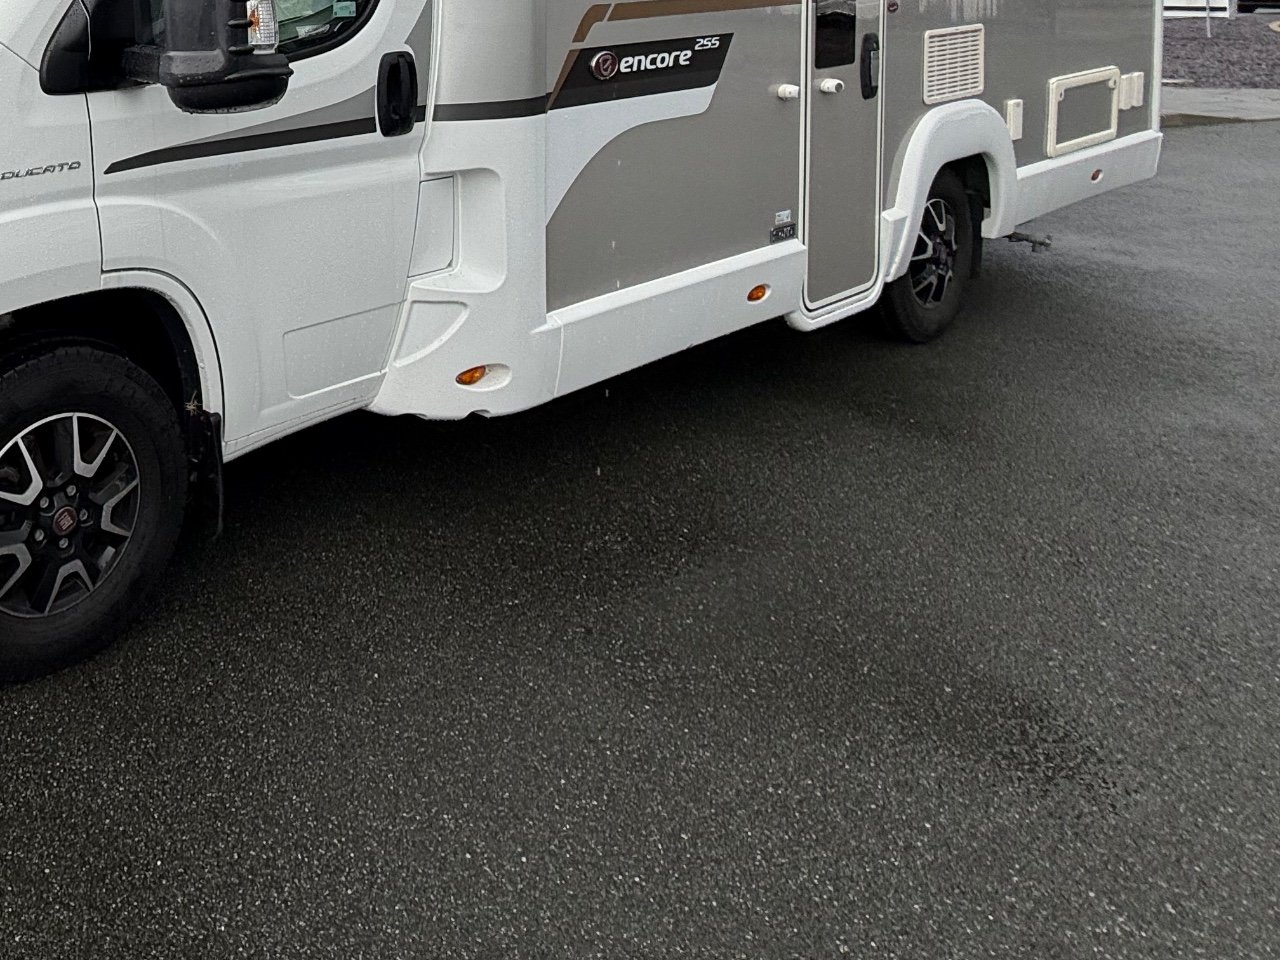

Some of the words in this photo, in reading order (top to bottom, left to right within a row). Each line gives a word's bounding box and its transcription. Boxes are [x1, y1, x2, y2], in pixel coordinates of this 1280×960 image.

[619, 49, 693, 73] encore
[694, 36, 720, 51] 255
[0, 160, 82, 181] DUCATO
